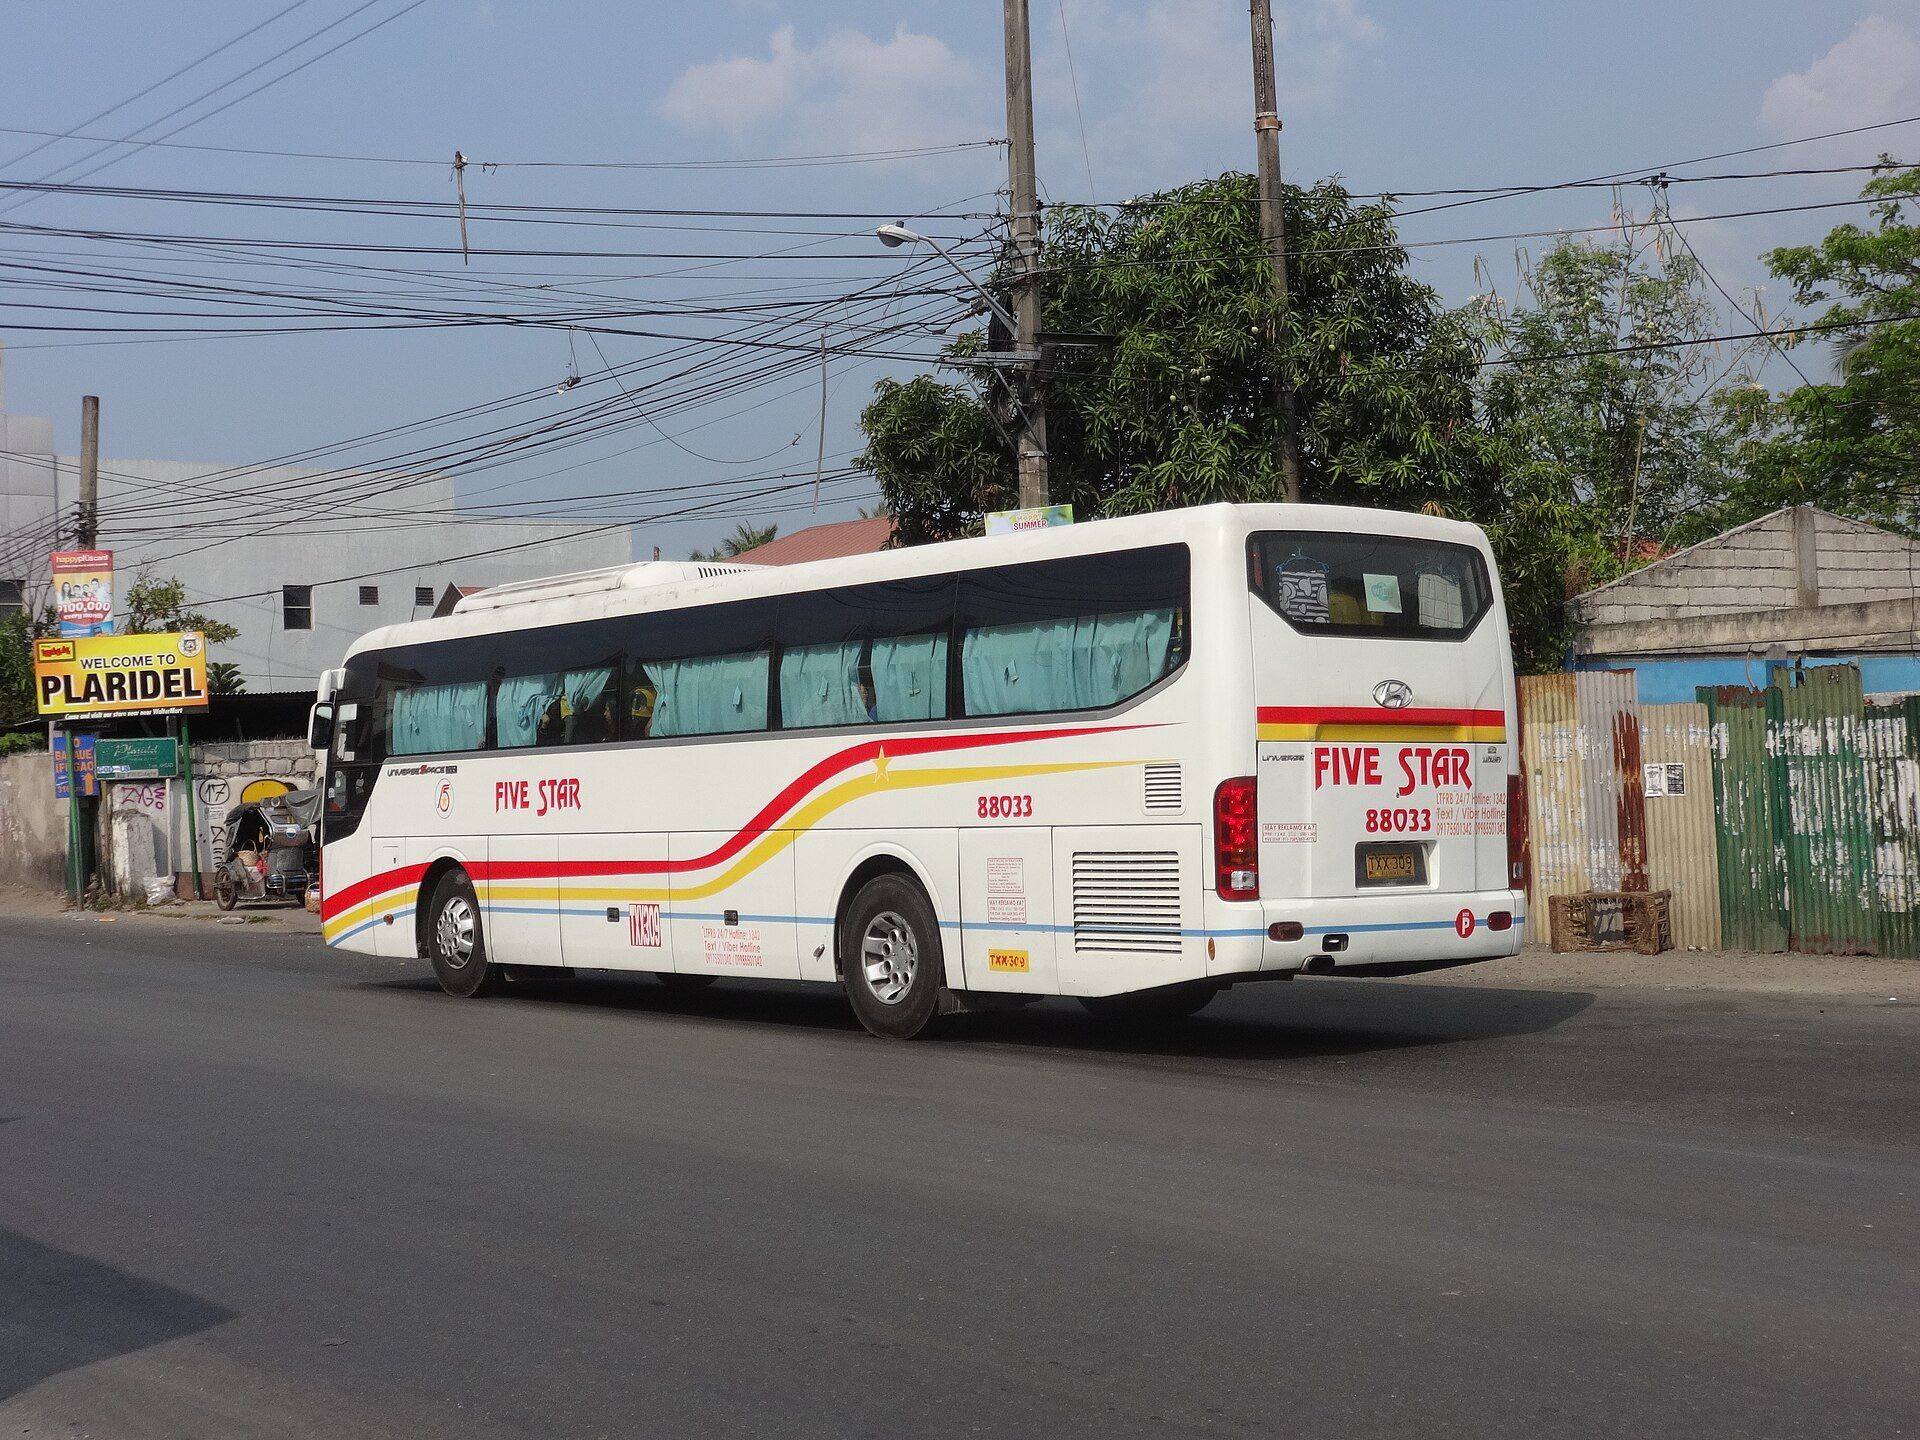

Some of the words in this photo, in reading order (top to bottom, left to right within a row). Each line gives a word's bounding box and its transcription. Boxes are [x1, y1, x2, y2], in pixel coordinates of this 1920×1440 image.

[1013, 520, 1047, 531] SUMMER
[80, 655, 153, 670] WELCOME
[157, 653, 176, 665] TO
[41, 667, 203, 706] PLARIDEL
[113, 710, 127, 718] store
[54, 749, 92, 761] BAAUE
[1261, 754, 1305, 762] UNIVERSE
[55, 761, 94, 773] IFGAO
[1314, 747, 1383, 791] FIVE
[1398, 747, 1473, 797] STAR
[205, 783, 227, 803] 17
[495, 781, 530, 813] FIVE
[536, 778, 582, 816] STAR
[1436, 793, 1454, 805] LTFRB
[1455, 793, 1470, 806] 24/7
[1493, 793, 1506, 805] 1342
[977, 794, 1033, 819] 88033
[1436, 807, 1454, 820] Text
[1461, 807, 1480, 820] Viber
[1481, 807, 1506, 820] Hotline
[1365, 808, 1432, 833] 88033
[1461, 917, 1470, 935] P
[704, 940, 717, 951] Text
[722, 941, 739, 952] Viber
[739, 941, 761, 954] Hotline
